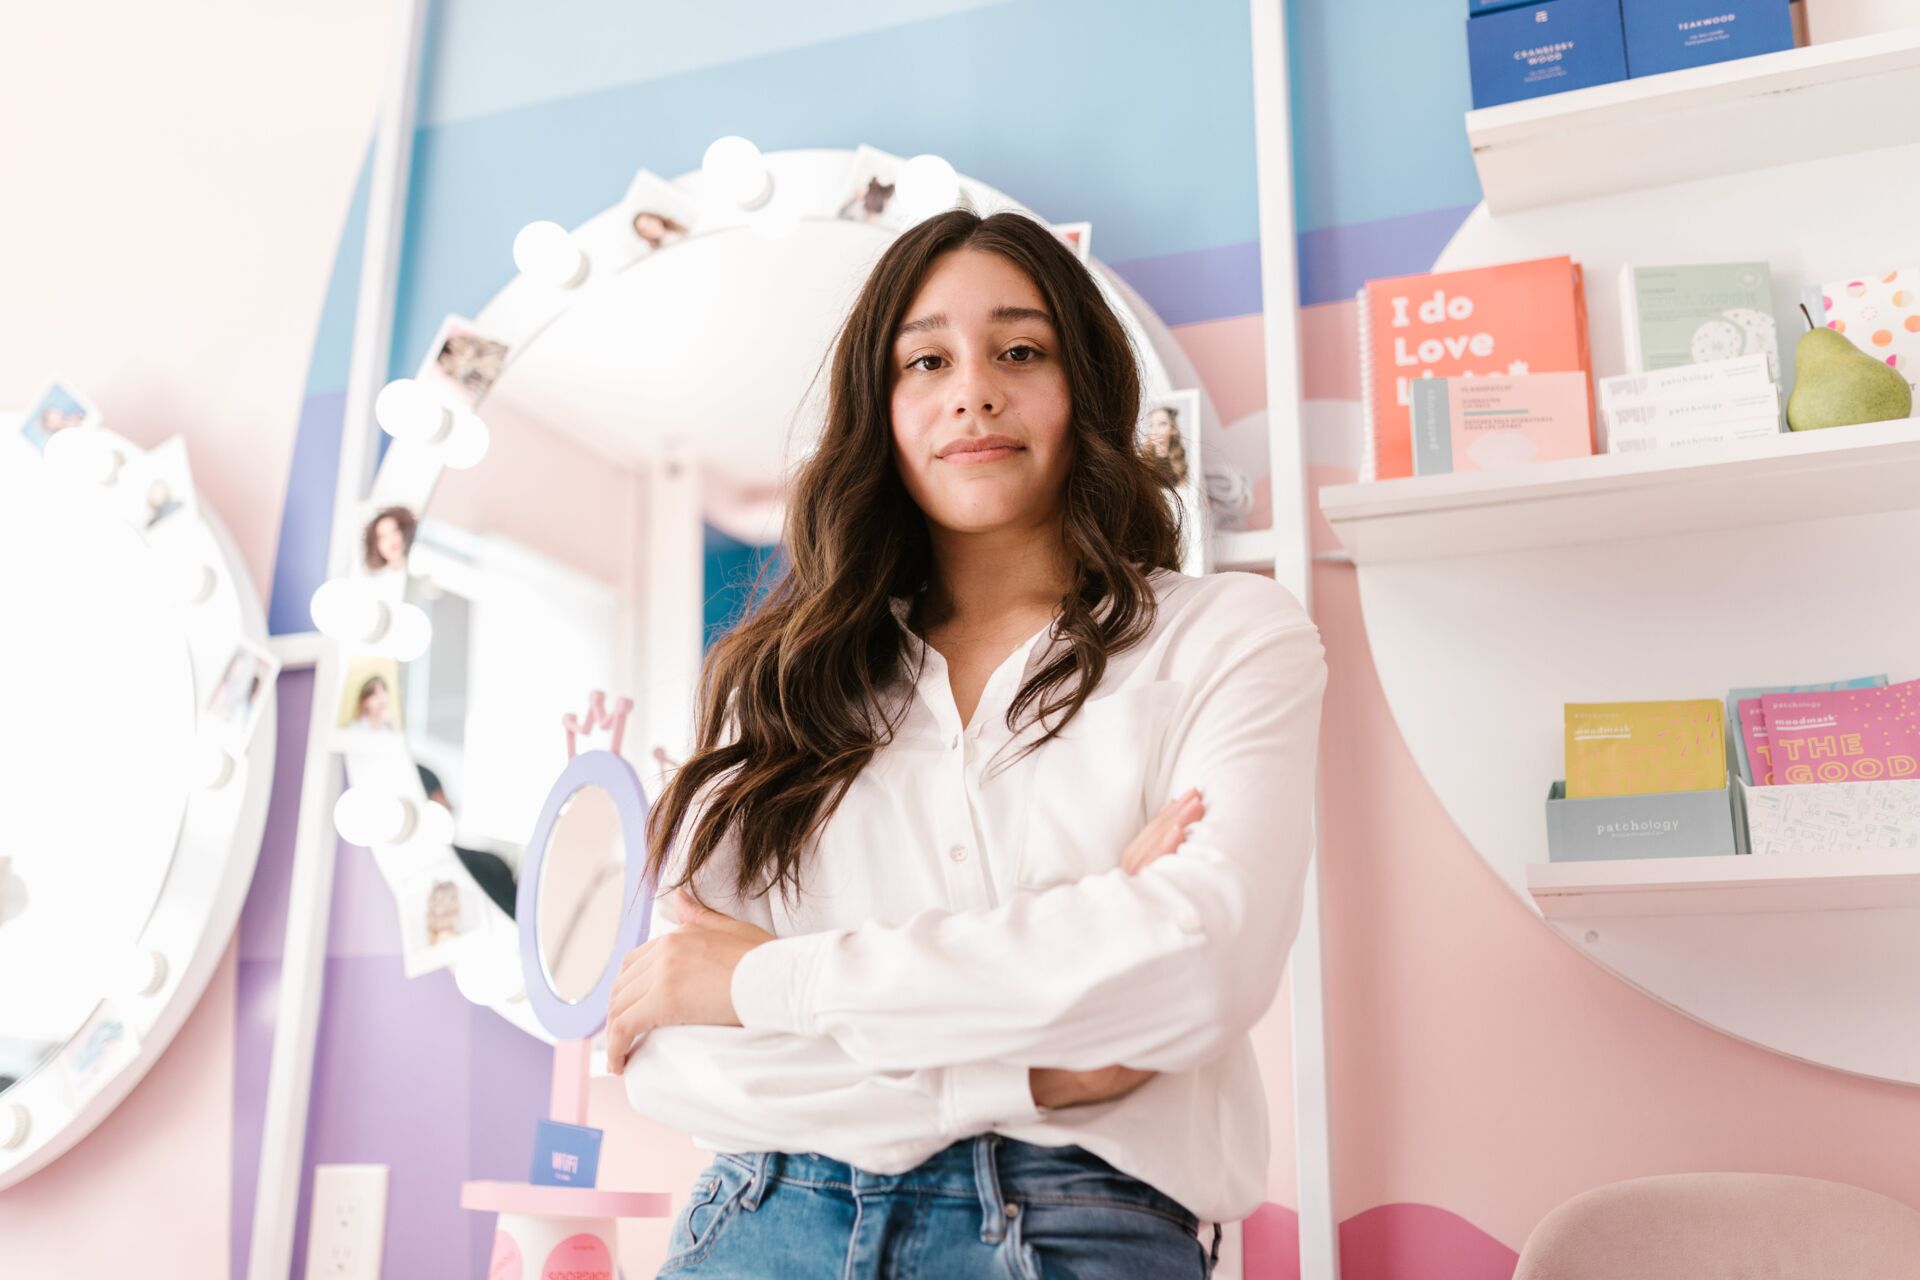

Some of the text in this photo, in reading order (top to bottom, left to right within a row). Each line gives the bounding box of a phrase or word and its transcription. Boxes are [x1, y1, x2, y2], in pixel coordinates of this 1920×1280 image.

[1678, 13, 1736, 31] TEAKWOOD
[1513, 40, 1576, 61] CRANBERRY
[1527, 53, 1563, 66] WOOD
[1391, 289, 1474, 328] I do
[1394, 332, 1495, 367] Love
[1778, 733, 1865, 761] THE
[1785, 755, 1918, 785] GOOD
[1596, 818, 1680, 836] patchology
